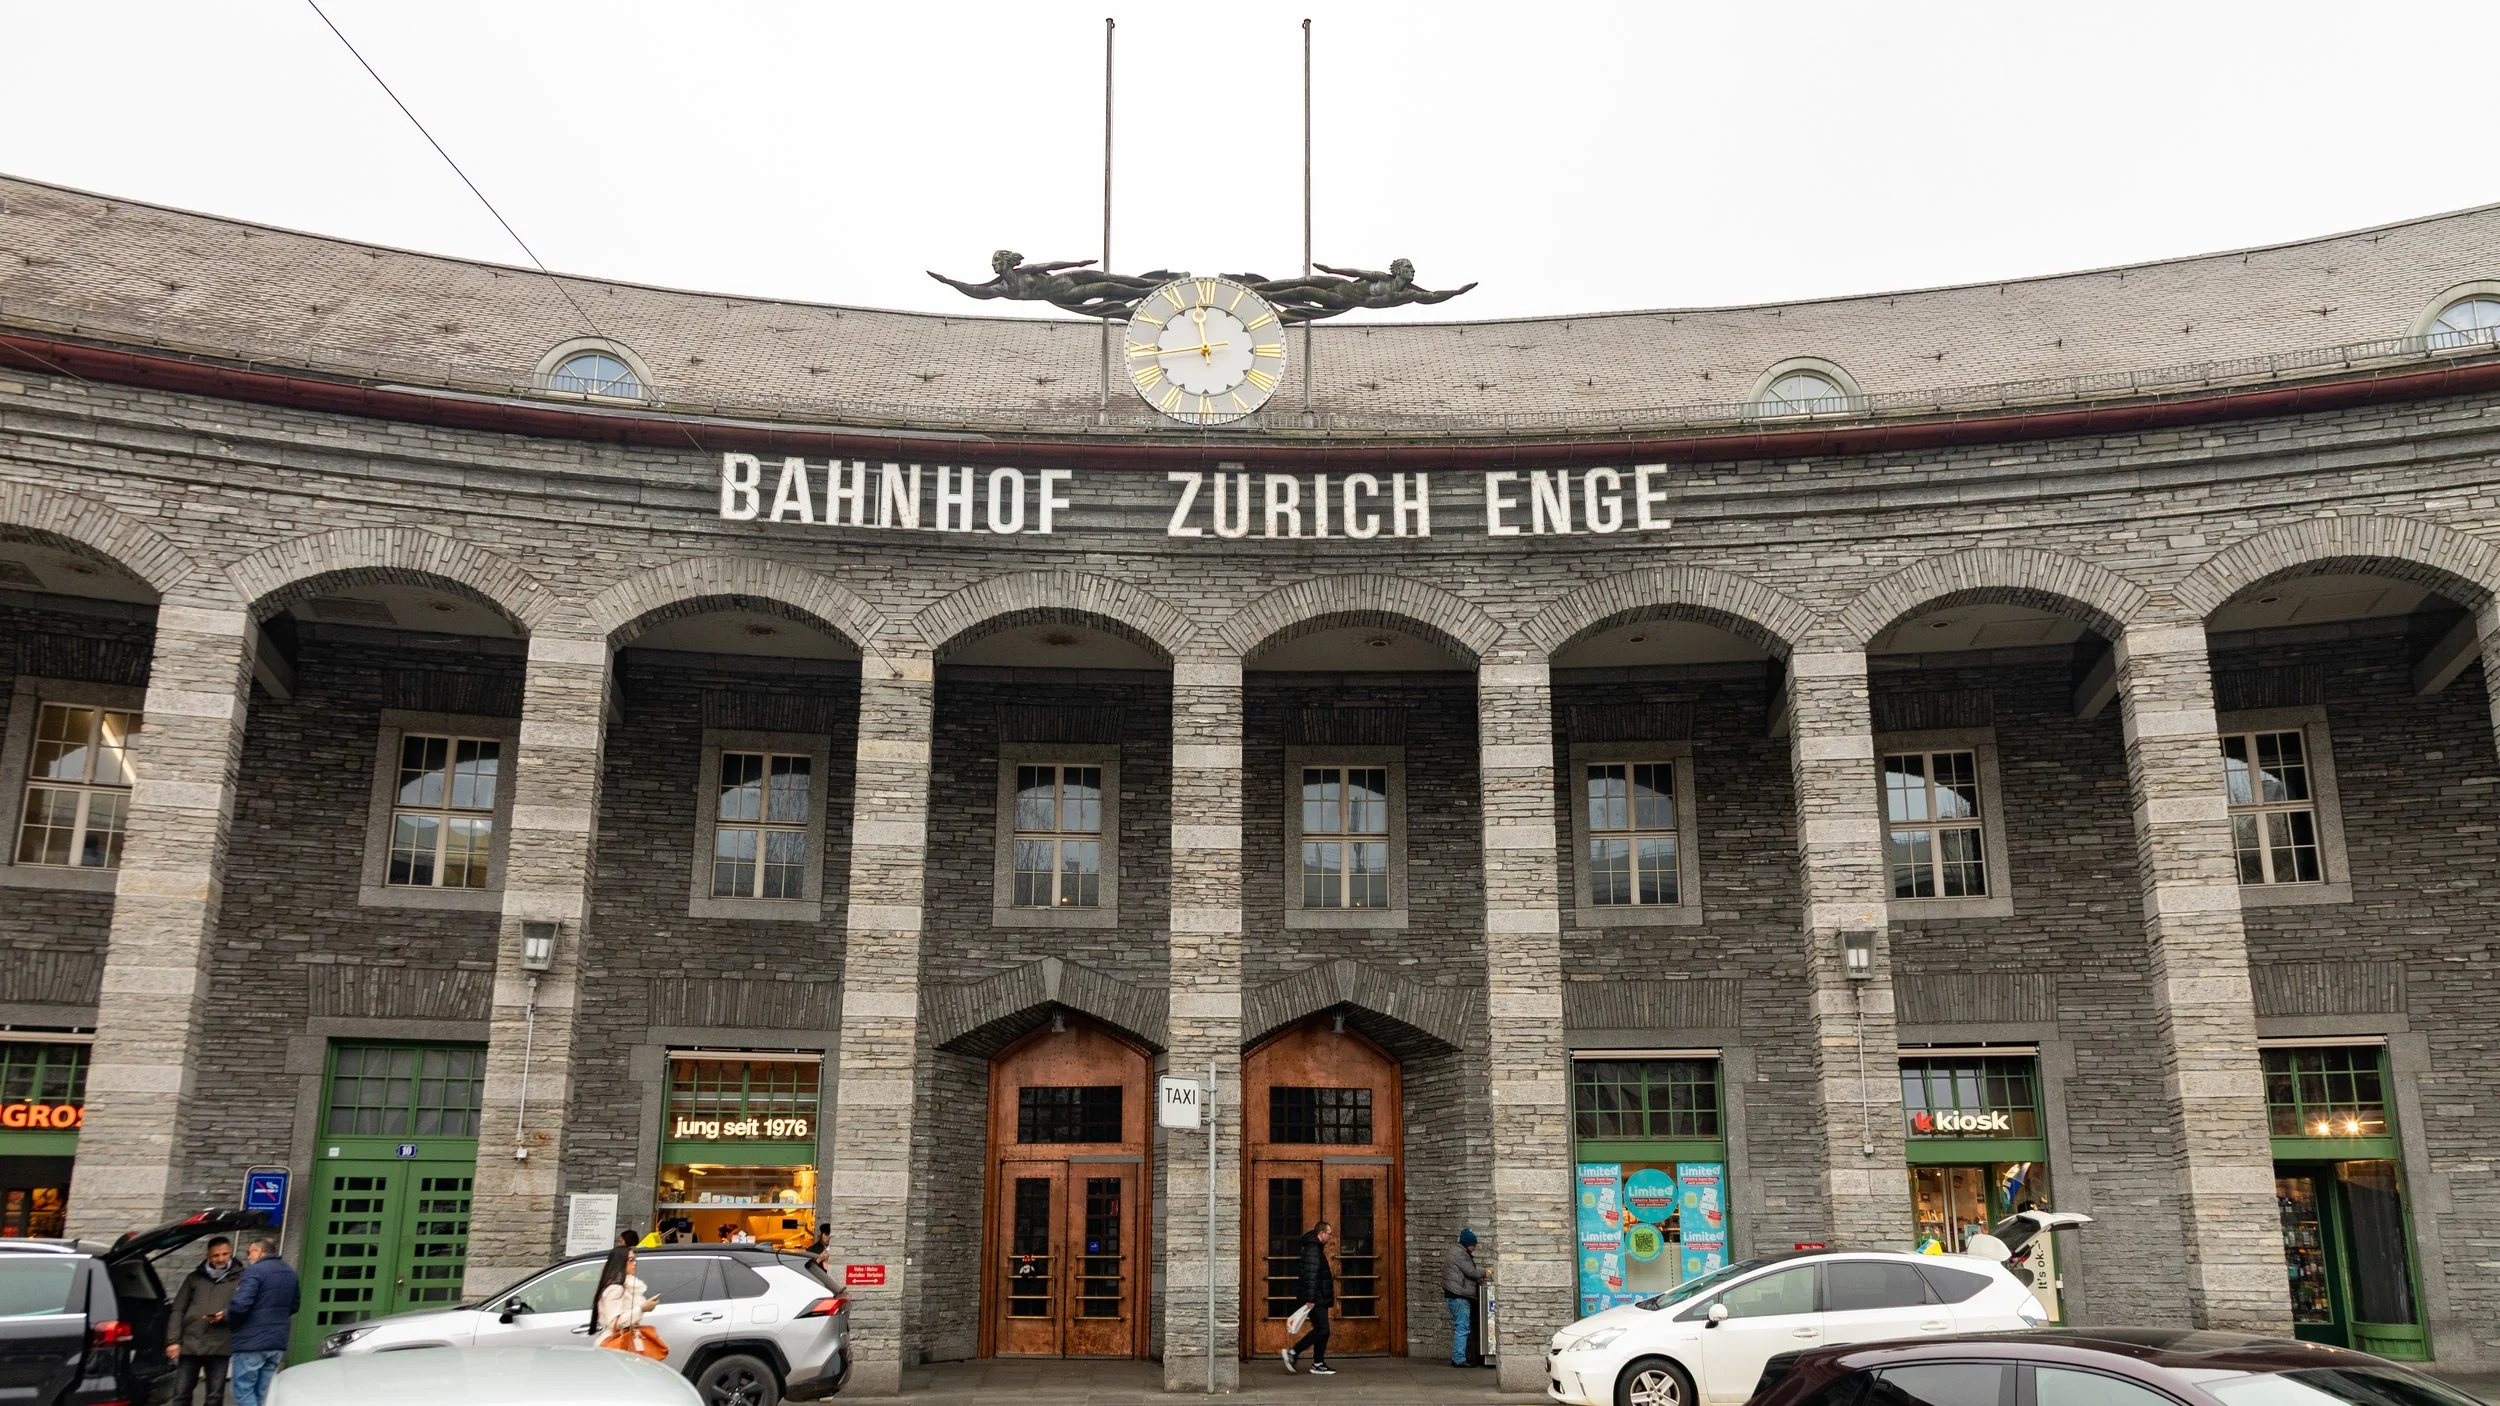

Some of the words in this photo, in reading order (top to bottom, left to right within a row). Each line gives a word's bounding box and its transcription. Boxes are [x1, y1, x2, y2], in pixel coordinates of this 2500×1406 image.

[720, 451, 1073, 535] BAHNHOF
[1167, 461, 1431, 539] ZÜRICH
[1485, 463, 1672, 536] ENGE
[1165, 1087, 1196, 1105] TAXI
[1916, 1111, 1934, 1131] k
[1936, 1110, 2010, 1131] kiosk
[674, 1117, 720, 1139] jung
[723, 1118, 759, 1136] seit
[763, 1119, 808, 1137] 1976
[402, 1146, 412, 1156] 10
[1578, 1165, 1619, 1177] Limited
[1680, 1165, 1721, 1176] Limited
[1628, 1185, 1674, 1197] Limited
[1581, 1230, 1622, 1242] Limited
[1683, 1230, 1724, 1241] Limited
[2037, 1271, 2047, 1289] It's
